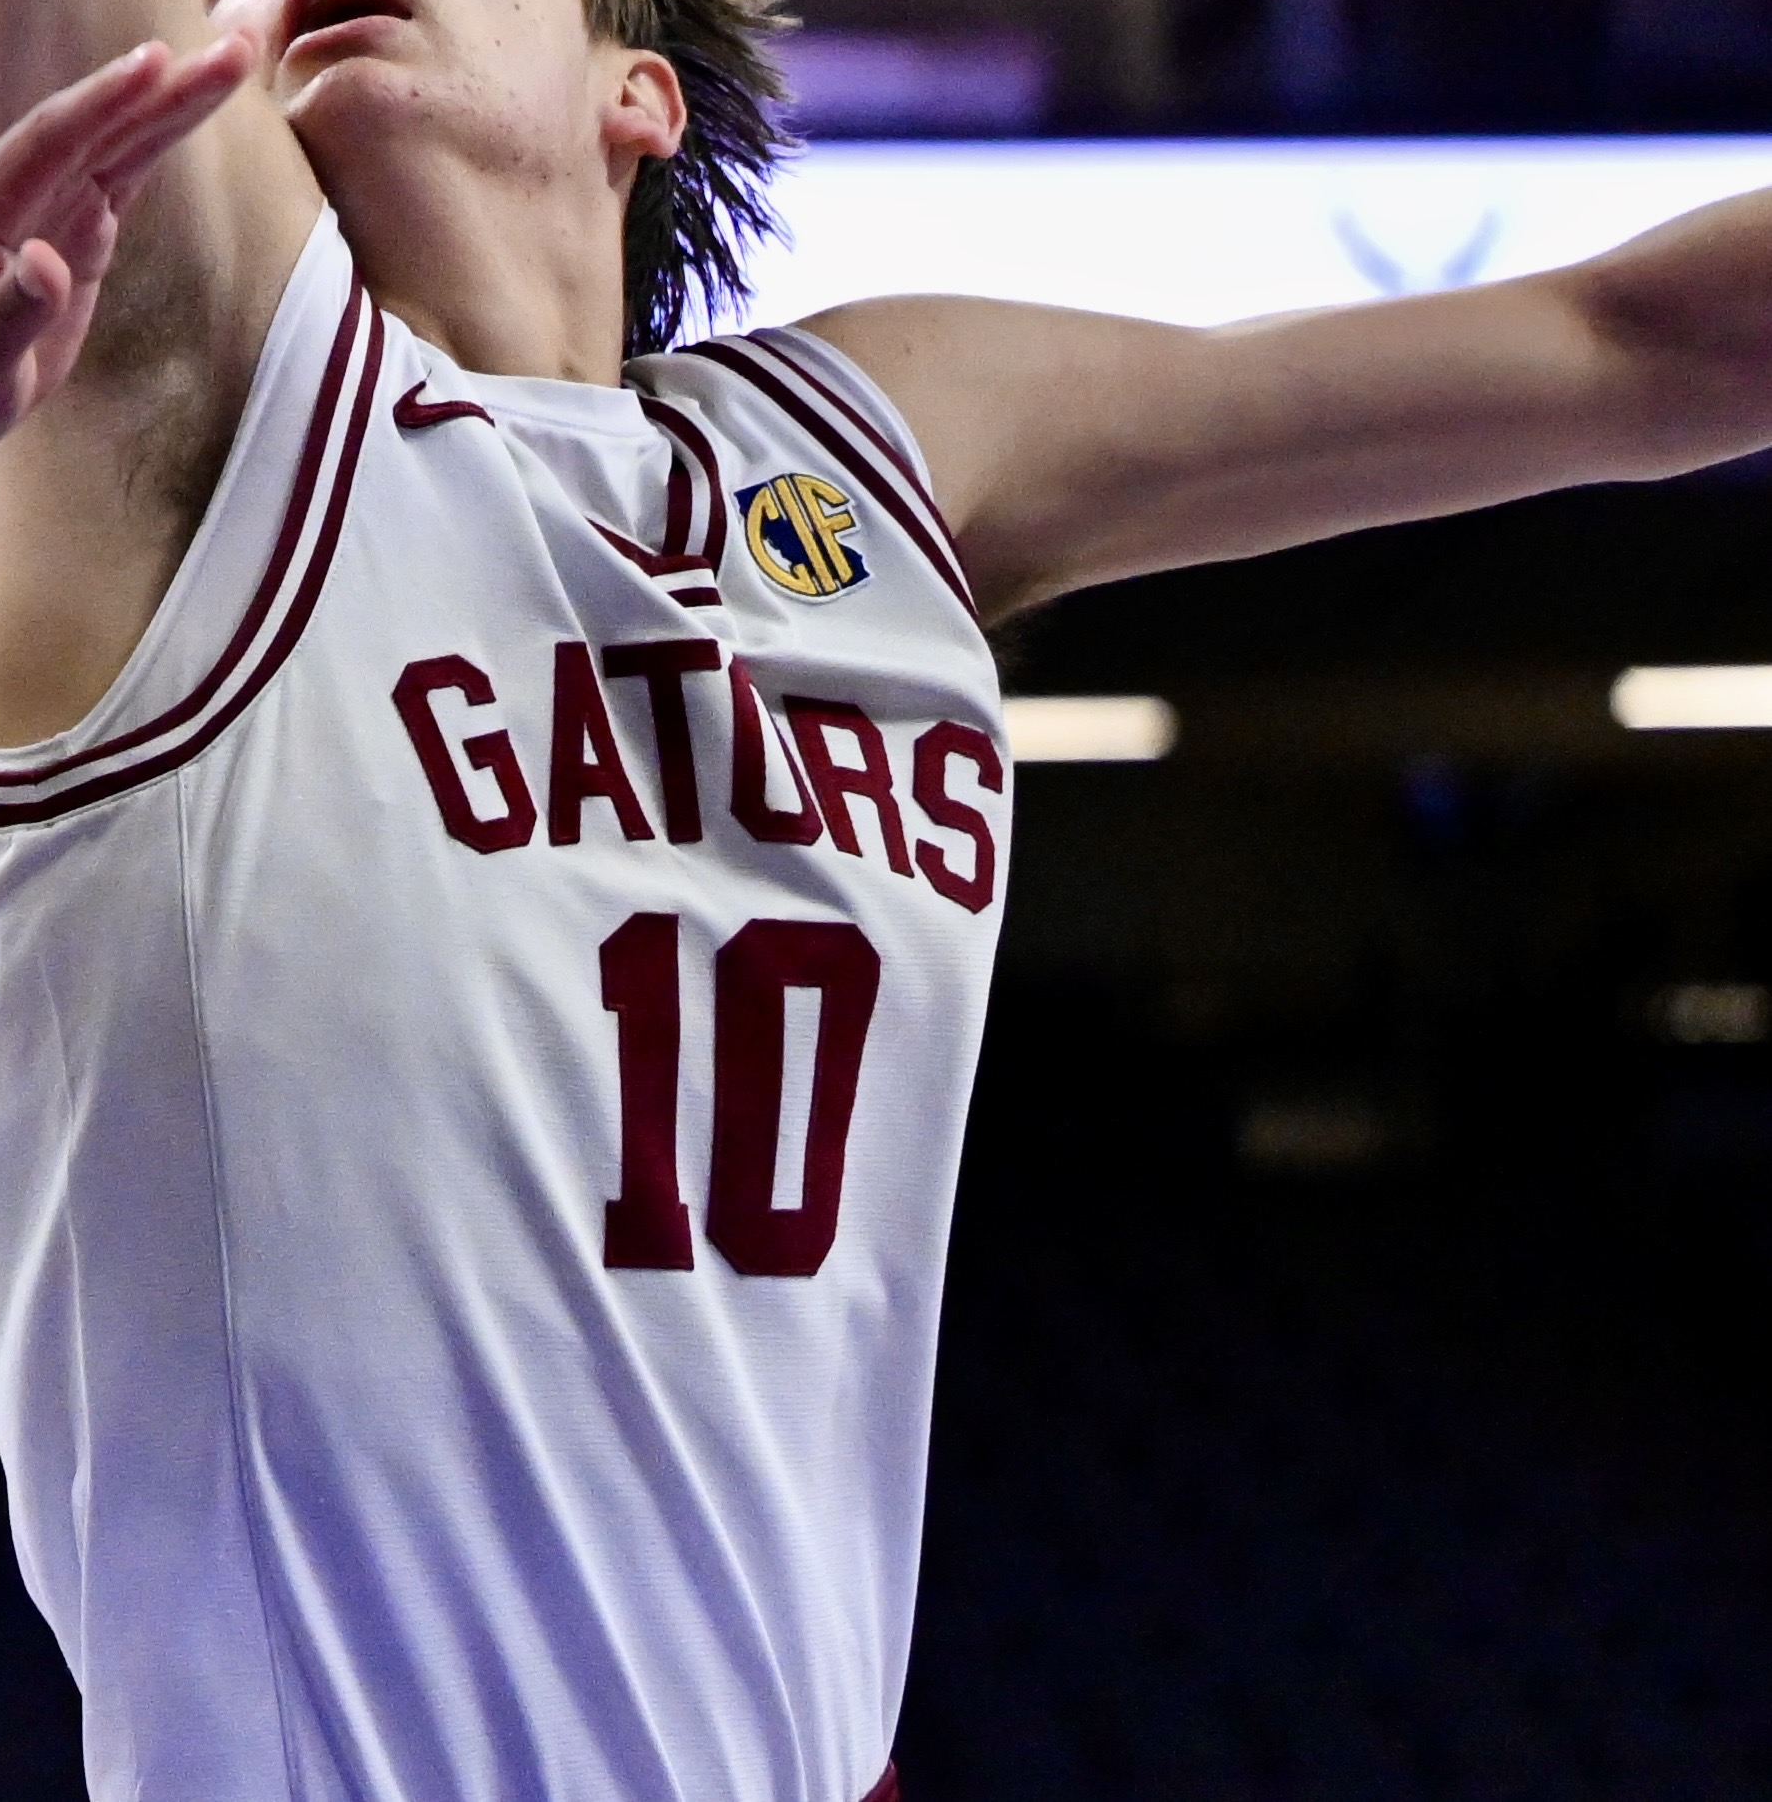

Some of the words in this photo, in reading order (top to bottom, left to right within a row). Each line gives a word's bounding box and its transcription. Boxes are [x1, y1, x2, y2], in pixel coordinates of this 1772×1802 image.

[745, 473, 857, 596] CIF
[391, 638, 1004, 915] GATORS
[598, 912, 882, 1276] 10
